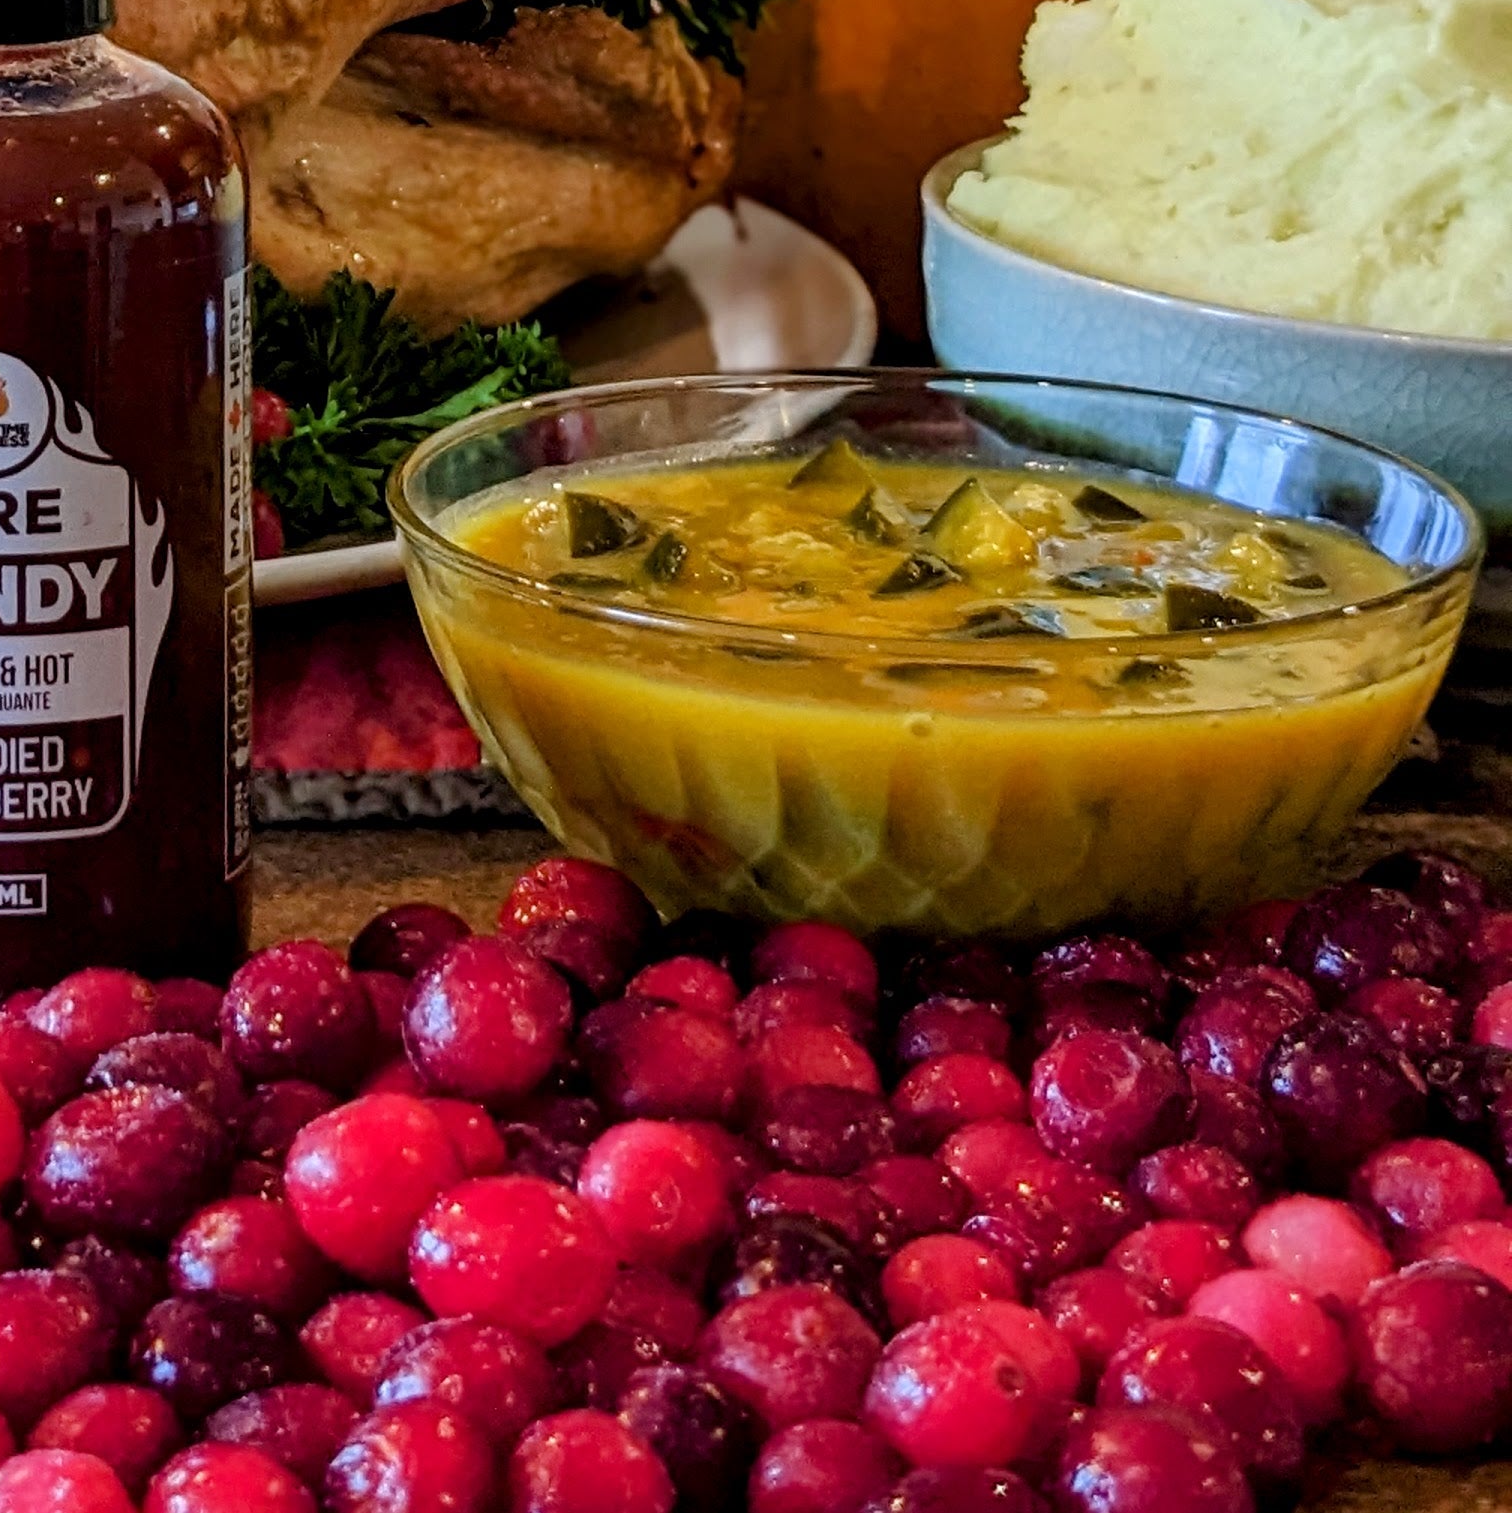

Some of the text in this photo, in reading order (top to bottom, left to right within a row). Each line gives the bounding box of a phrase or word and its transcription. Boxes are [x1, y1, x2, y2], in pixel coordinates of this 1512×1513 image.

[230, 446, 240, 559] MADE
[0, 656, 16, 686] &
[24, 653, 74, 685] HOT
